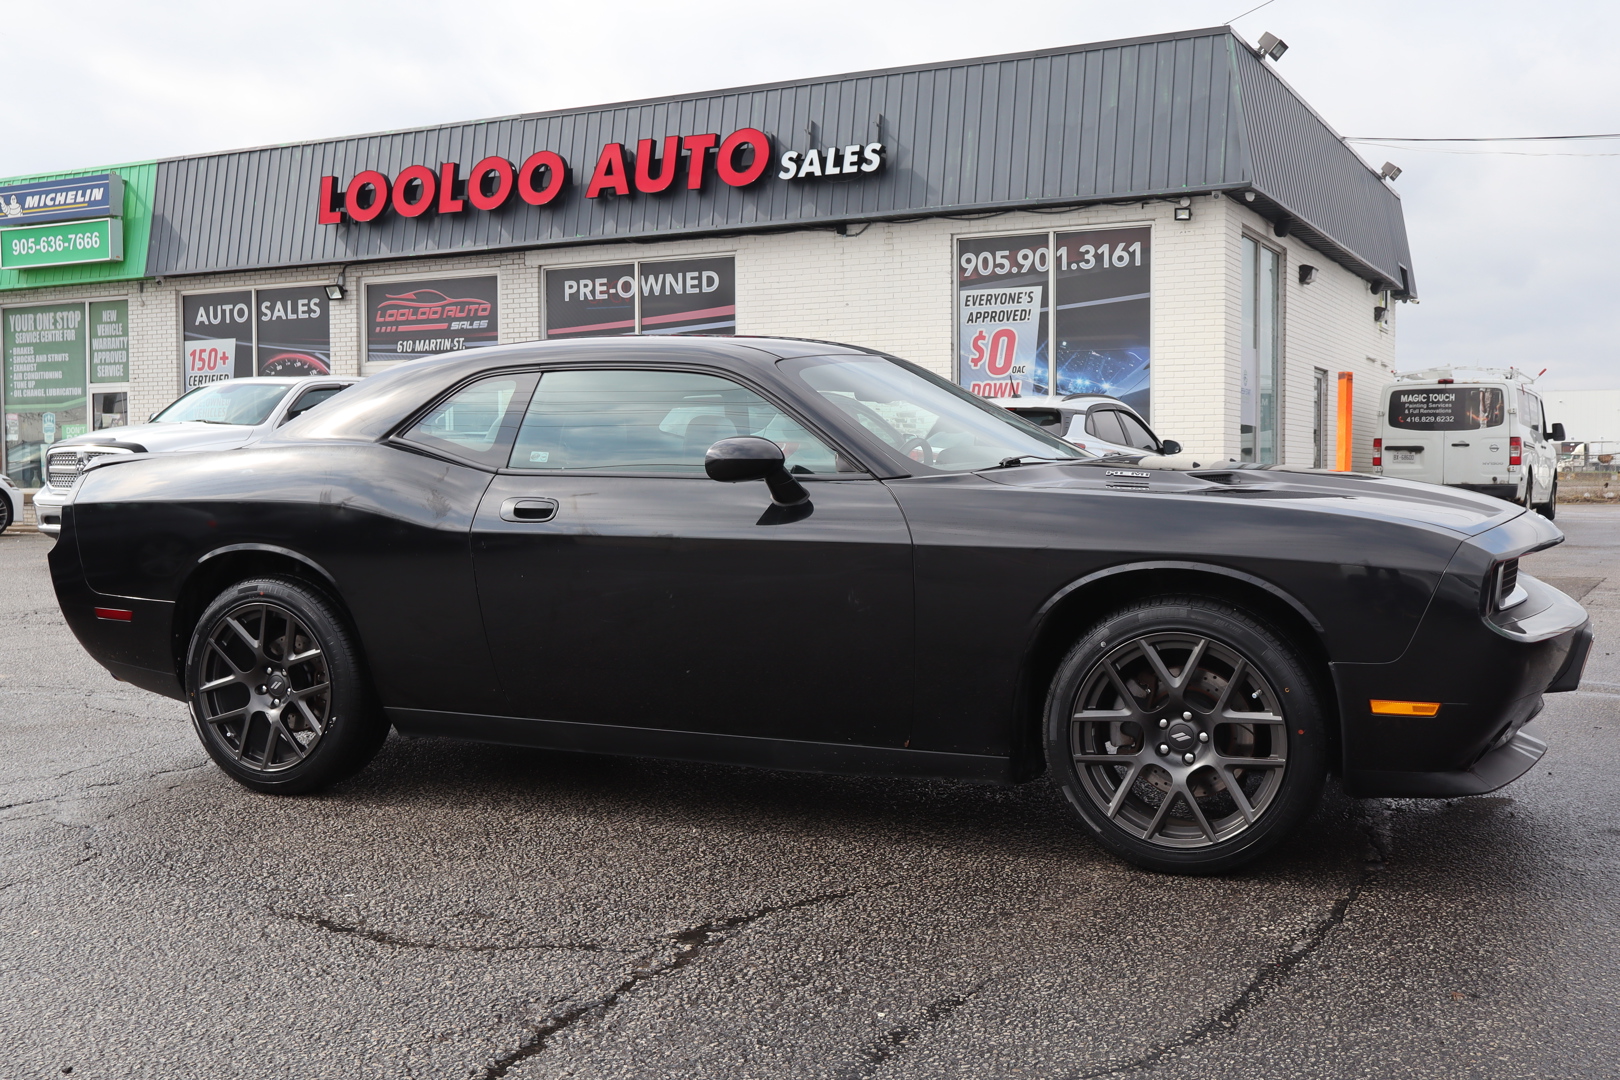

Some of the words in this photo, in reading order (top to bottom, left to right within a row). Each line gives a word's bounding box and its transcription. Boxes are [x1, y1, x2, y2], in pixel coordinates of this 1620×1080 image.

[318, 151, 565, 225] LOOLOO
[585, 128, 770, 198] AUTO
[778, 142, 882, 180] SALES
[25, 187, 104, 208] MICHELIN
[12, 231, 100, 256] 905-636-7666
[960, 241, 1141, 277] 905.901.3161
[564, 270, 719, 302] PRE-OWNED
[964, 291, 1034, 307] EVERYONE'S
[102, 310, 117, 322] NEW
[195, 303, 249, 326] AUTO
[261, 298, 321, 321] SALES
[376, 307, 442, 322] LOOLOO
[443, 304, 491, 318] AUTO
[966, 309, 1031, 325] APPROVED!
[9, 313, 34, 332] YOUR
[36, 312, 54, 330] ONE
[56, 310, 81, 329] STOP
[451, 320, 488, 330] SALES
[15, 331, 40, 344] SERVICE
[40, 330, 63, 342] CENTRE
[64, 329, 76, 341] FOR
[97, 323, 122, 336] VEHICLE
[92, 336, 128, 350] WARRANTY
[396, 340, 412, 352] 610
[414, 338, 450, 352] MARTIN
[453, 337, 465, 350] ST.
[13, 347, 34, 355] BRAKES
[13, 355, 35, 363] SHOCKS
[36, 354, 47, 363] AND
[48, 353, 69, 362] STRUTS
[93, 351, 127, 364] APPROVED
[970, 329, 1016, 376] $0
[1011, 365, 1025, 374] OAC
[189, 348, 229, 372] 150+
[13, 363, 37, 372] EXHAUST
[97, 364, 123, 377] SERVICE
[13, 372, 23, 380] AIR
[24, 371, 62, 380] CONDITIONING
[188, 374, 229, 387] CERTIFIED
[14, 381, 27, 389] TUNE
[28, 380, 35, 388] UP
[14, 389, 22, 398] OIL
[46, 387, 82, 397] LUBRICATION
[1400, 394, 1428, 402] MAGIC
[1429, 393, 1455, 402] TOUCH
[66, 426, 85, 434] DON'T
